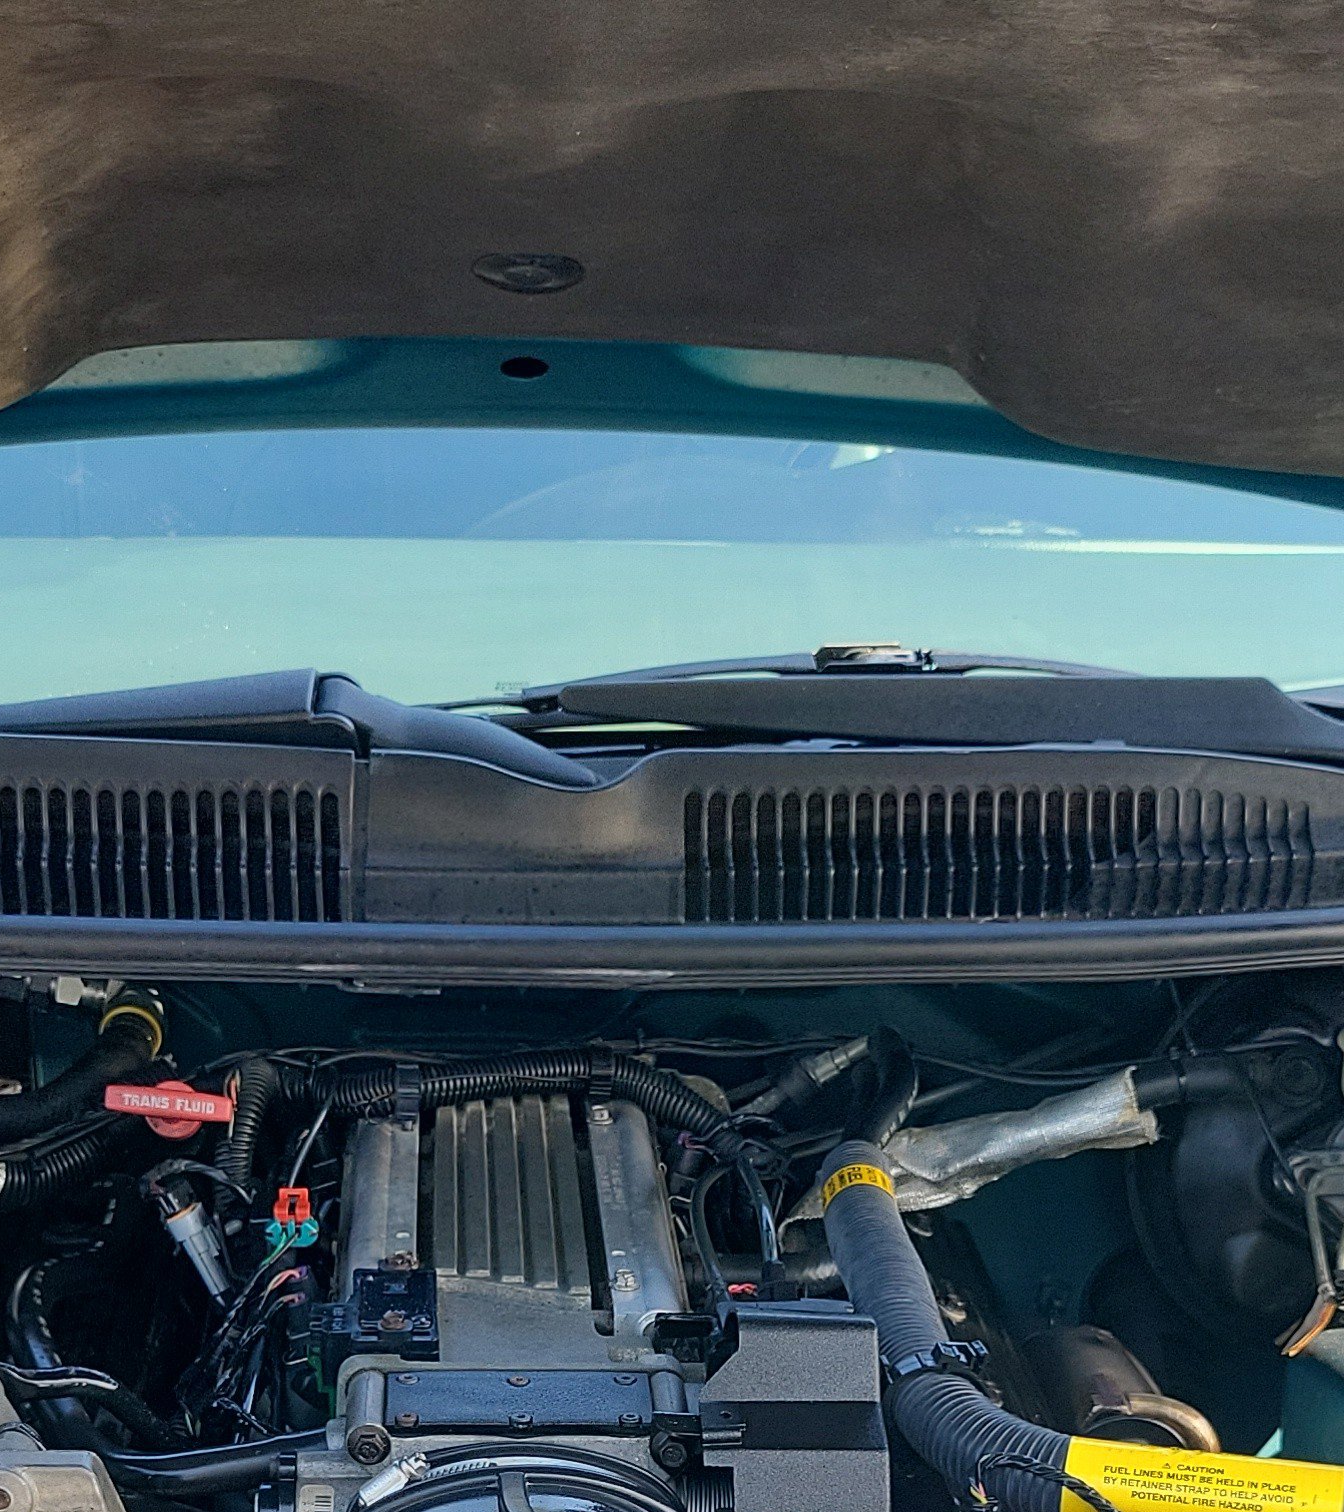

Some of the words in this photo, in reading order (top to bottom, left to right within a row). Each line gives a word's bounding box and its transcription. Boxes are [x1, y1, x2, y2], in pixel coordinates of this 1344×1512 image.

[122, 1093, 169, 1109] TRANS
[175, 1098, 215, 1114] FLUID
[1104, 1465, 1130, 1475] FUEL
[1133, 1468, 1163, 1478] LINES
[1167, 1471, 1196, 1482] MUST
[1200, 1475, 1214, 1484] BE
[1216, 1477, 1244, 1488] HELD
[1247, 1480, 1258, 1489] IN
[1261, 1482, 1296, 1494] PLACE
[1176, 1464, 1224, 1475] CAUTION
[1103, 1476, 1116, 1485] BY
[1121, 1478, 1172, 1492] RETAINER
[1176, 1483, 1210, 1495] STRAP
[1214, 1487, 1227, 1497] TO
[1230, 1489, 1258, 1500] HELP
[1260, 1493, 1293, 1504] AVOID
[1131, 1490, 1189, 1504] POTENTIAL
[1192, 1497, 1215, 1508] FIRE
[1218, 1500, 1262, 1512] HAZARD
